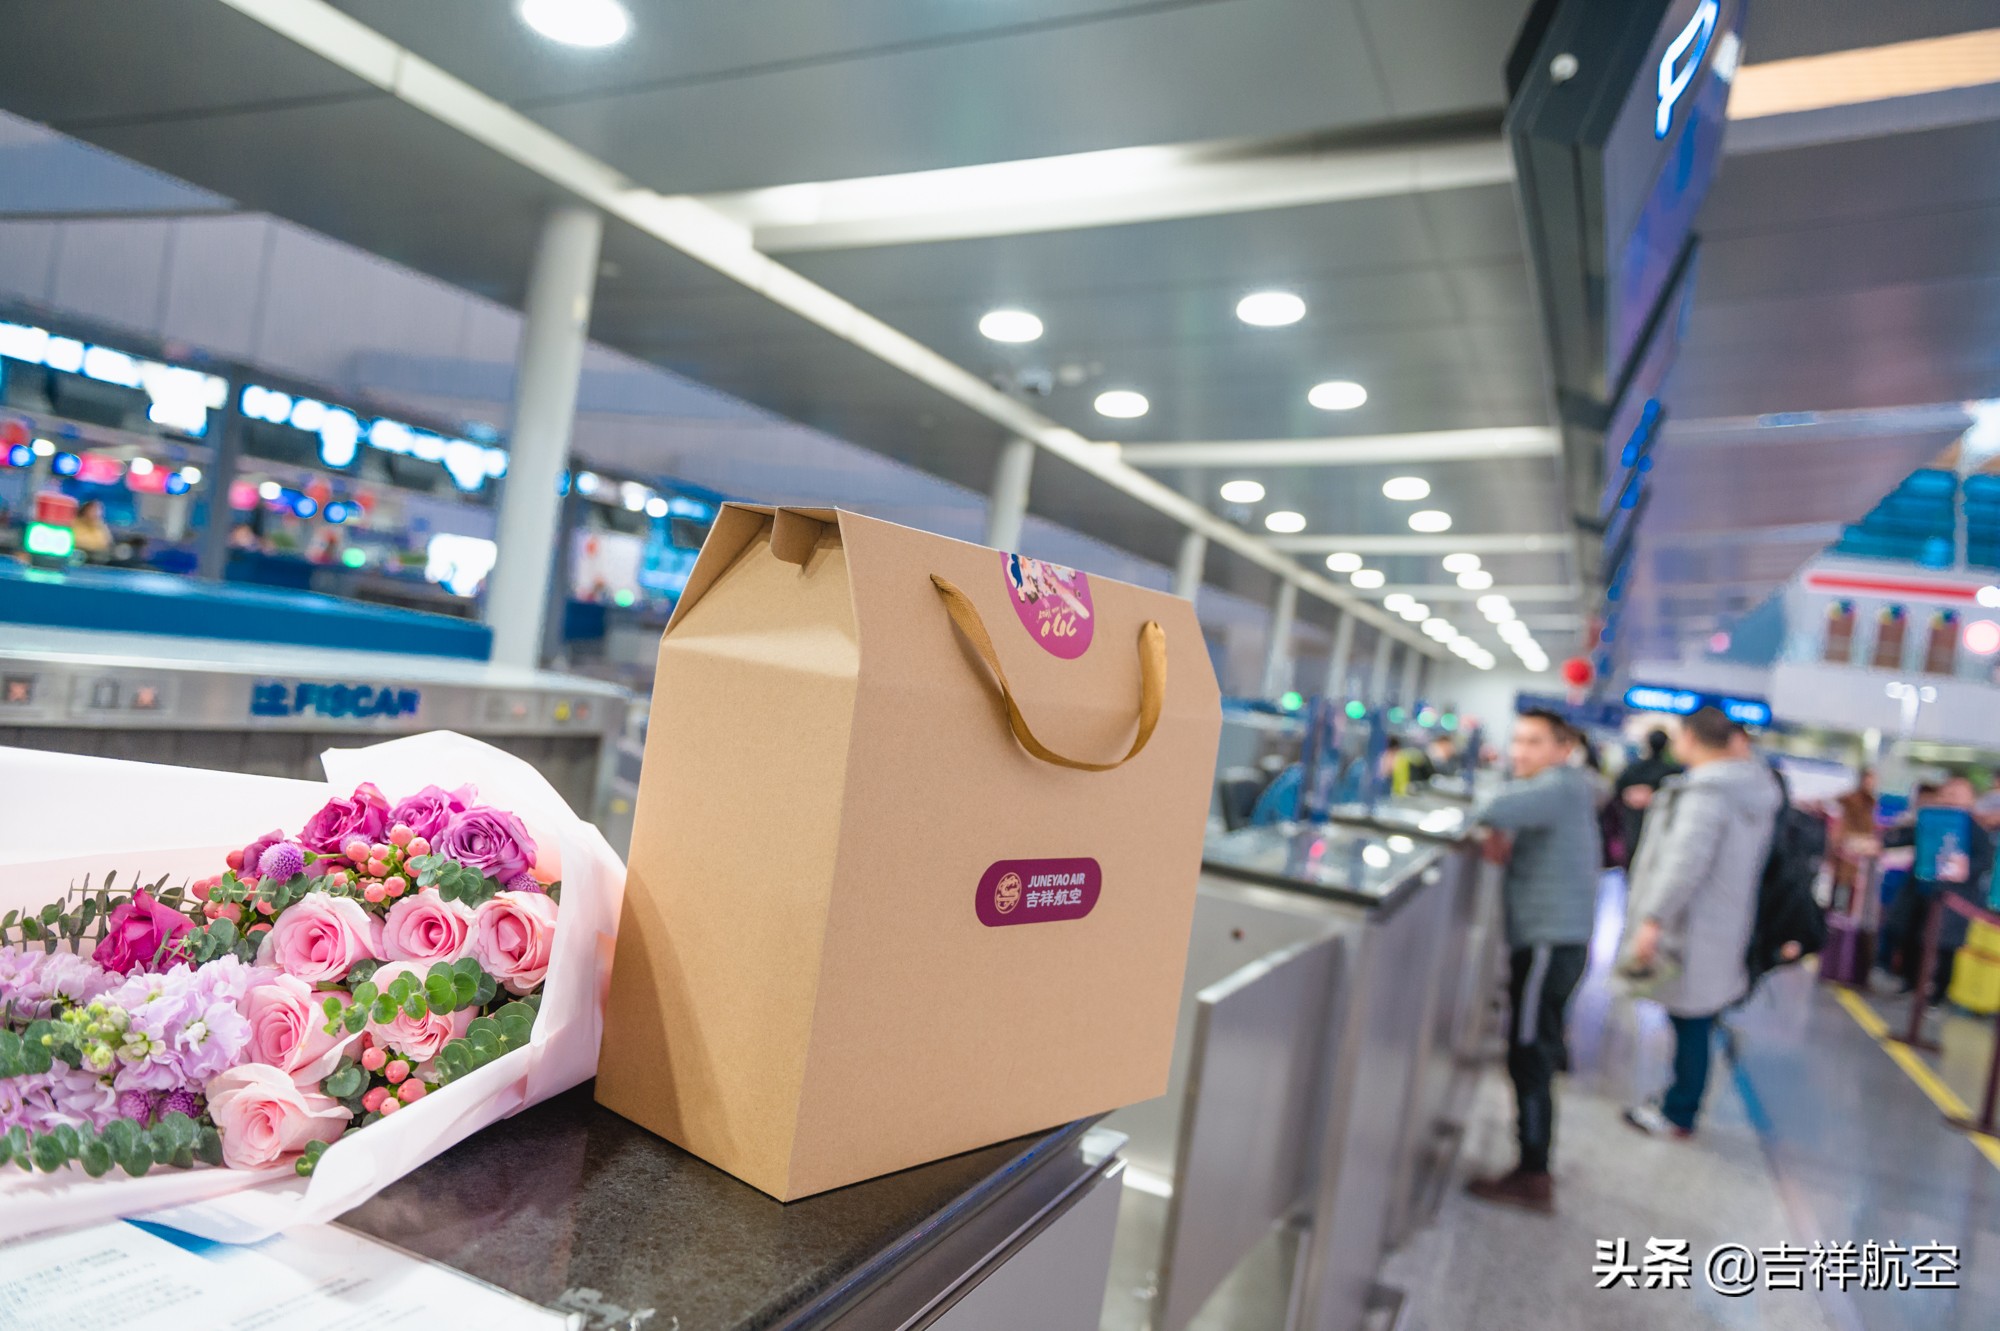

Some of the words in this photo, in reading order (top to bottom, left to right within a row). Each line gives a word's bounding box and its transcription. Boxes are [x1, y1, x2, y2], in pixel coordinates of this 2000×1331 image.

[1027, 873, 1070, 888] JUNEYAO
[1070, 872, 1086, 885] AIR
[1026, 887, 1082, 908] 吉祥航空
